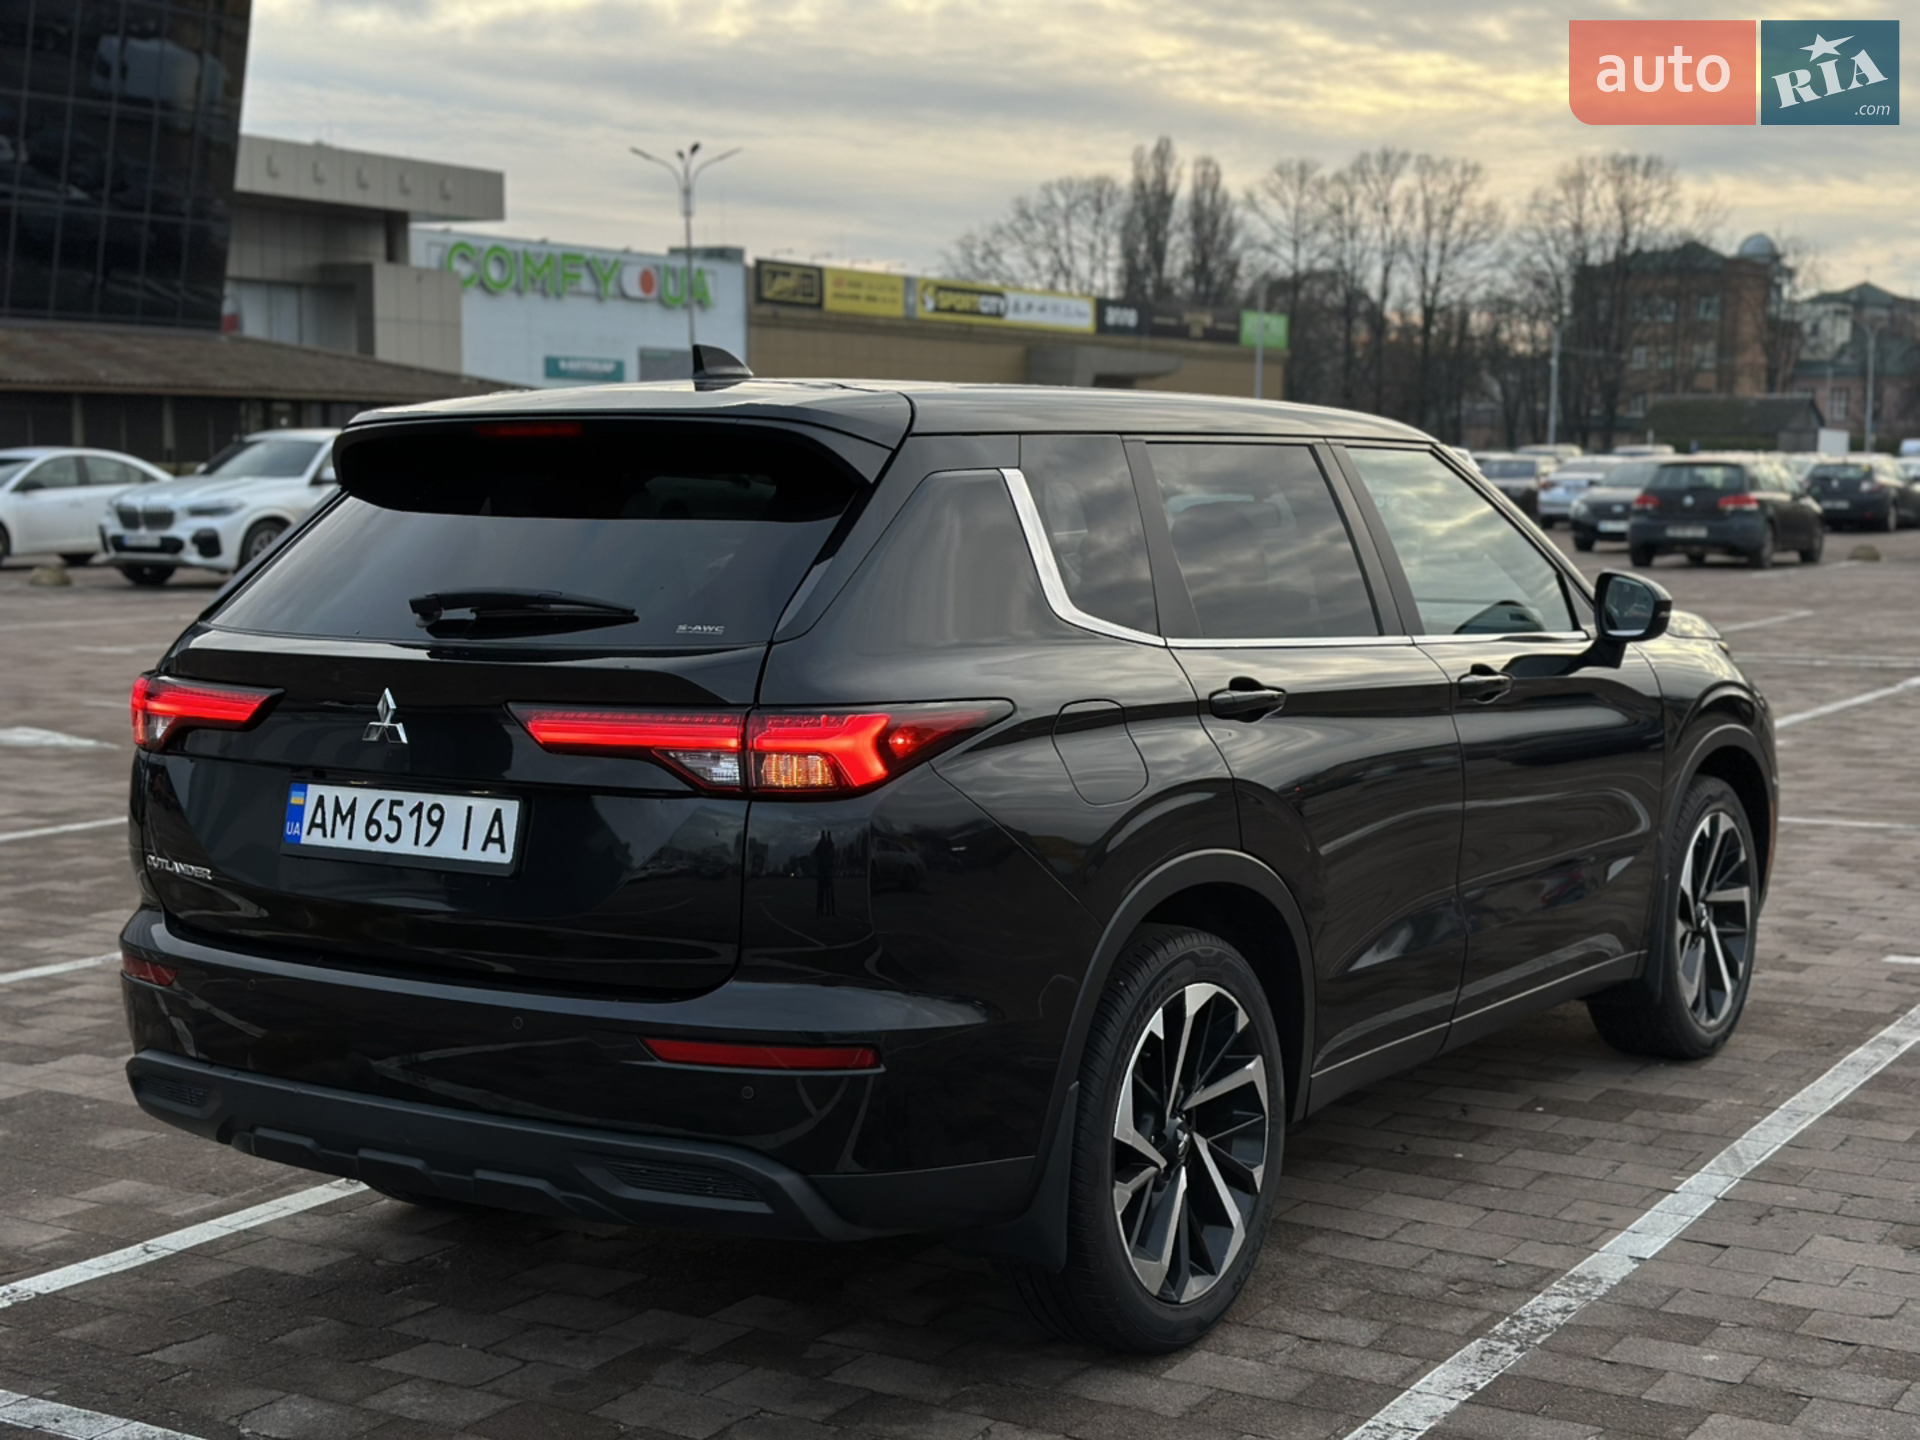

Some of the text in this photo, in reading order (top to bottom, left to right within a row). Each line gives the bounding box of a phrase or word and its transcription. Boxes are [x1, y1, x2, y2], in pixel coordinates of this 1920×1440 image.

[446, 241, 622, 299] COMFY
[286, 821, 301, 836] UA
[306, 793, 507, 854] AM 6519 IA
[146, 854, 213, 881] OUTLANDER
